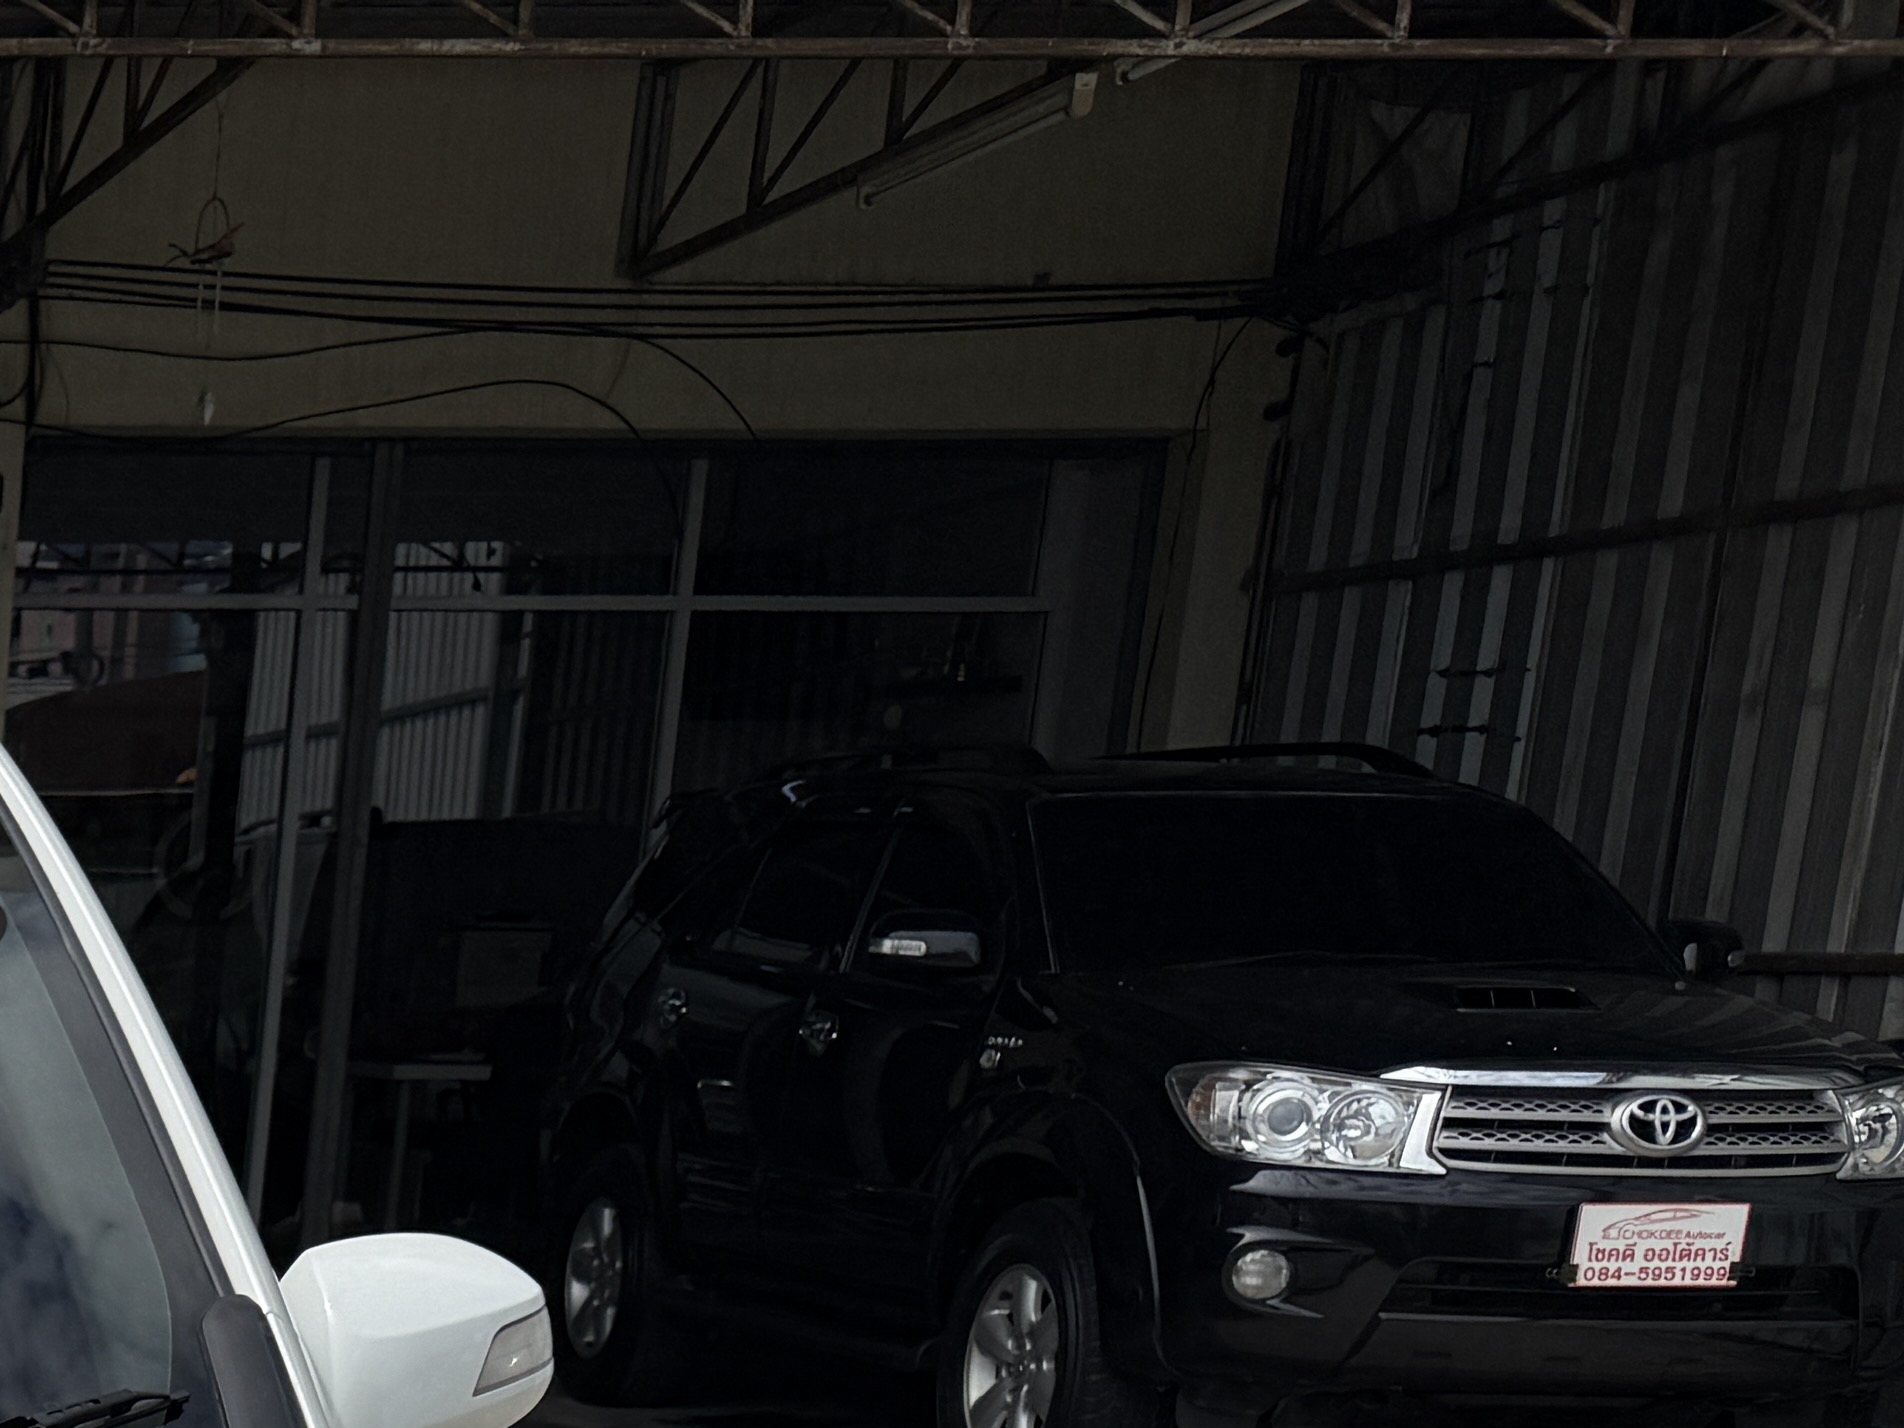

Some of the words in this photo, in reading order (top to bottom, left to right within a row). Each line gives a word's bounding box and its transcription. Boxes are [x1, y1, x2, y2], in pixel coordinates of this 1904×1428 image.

[1623, 1229, 1683, 1240] CHOKDEE
[1587, 1242, 1638, 1263] โชคดี
[1643, 1241, 1732, 1263] ออโต้คาร์
[1583, 1265, 1727, 1281] 084-5951999
